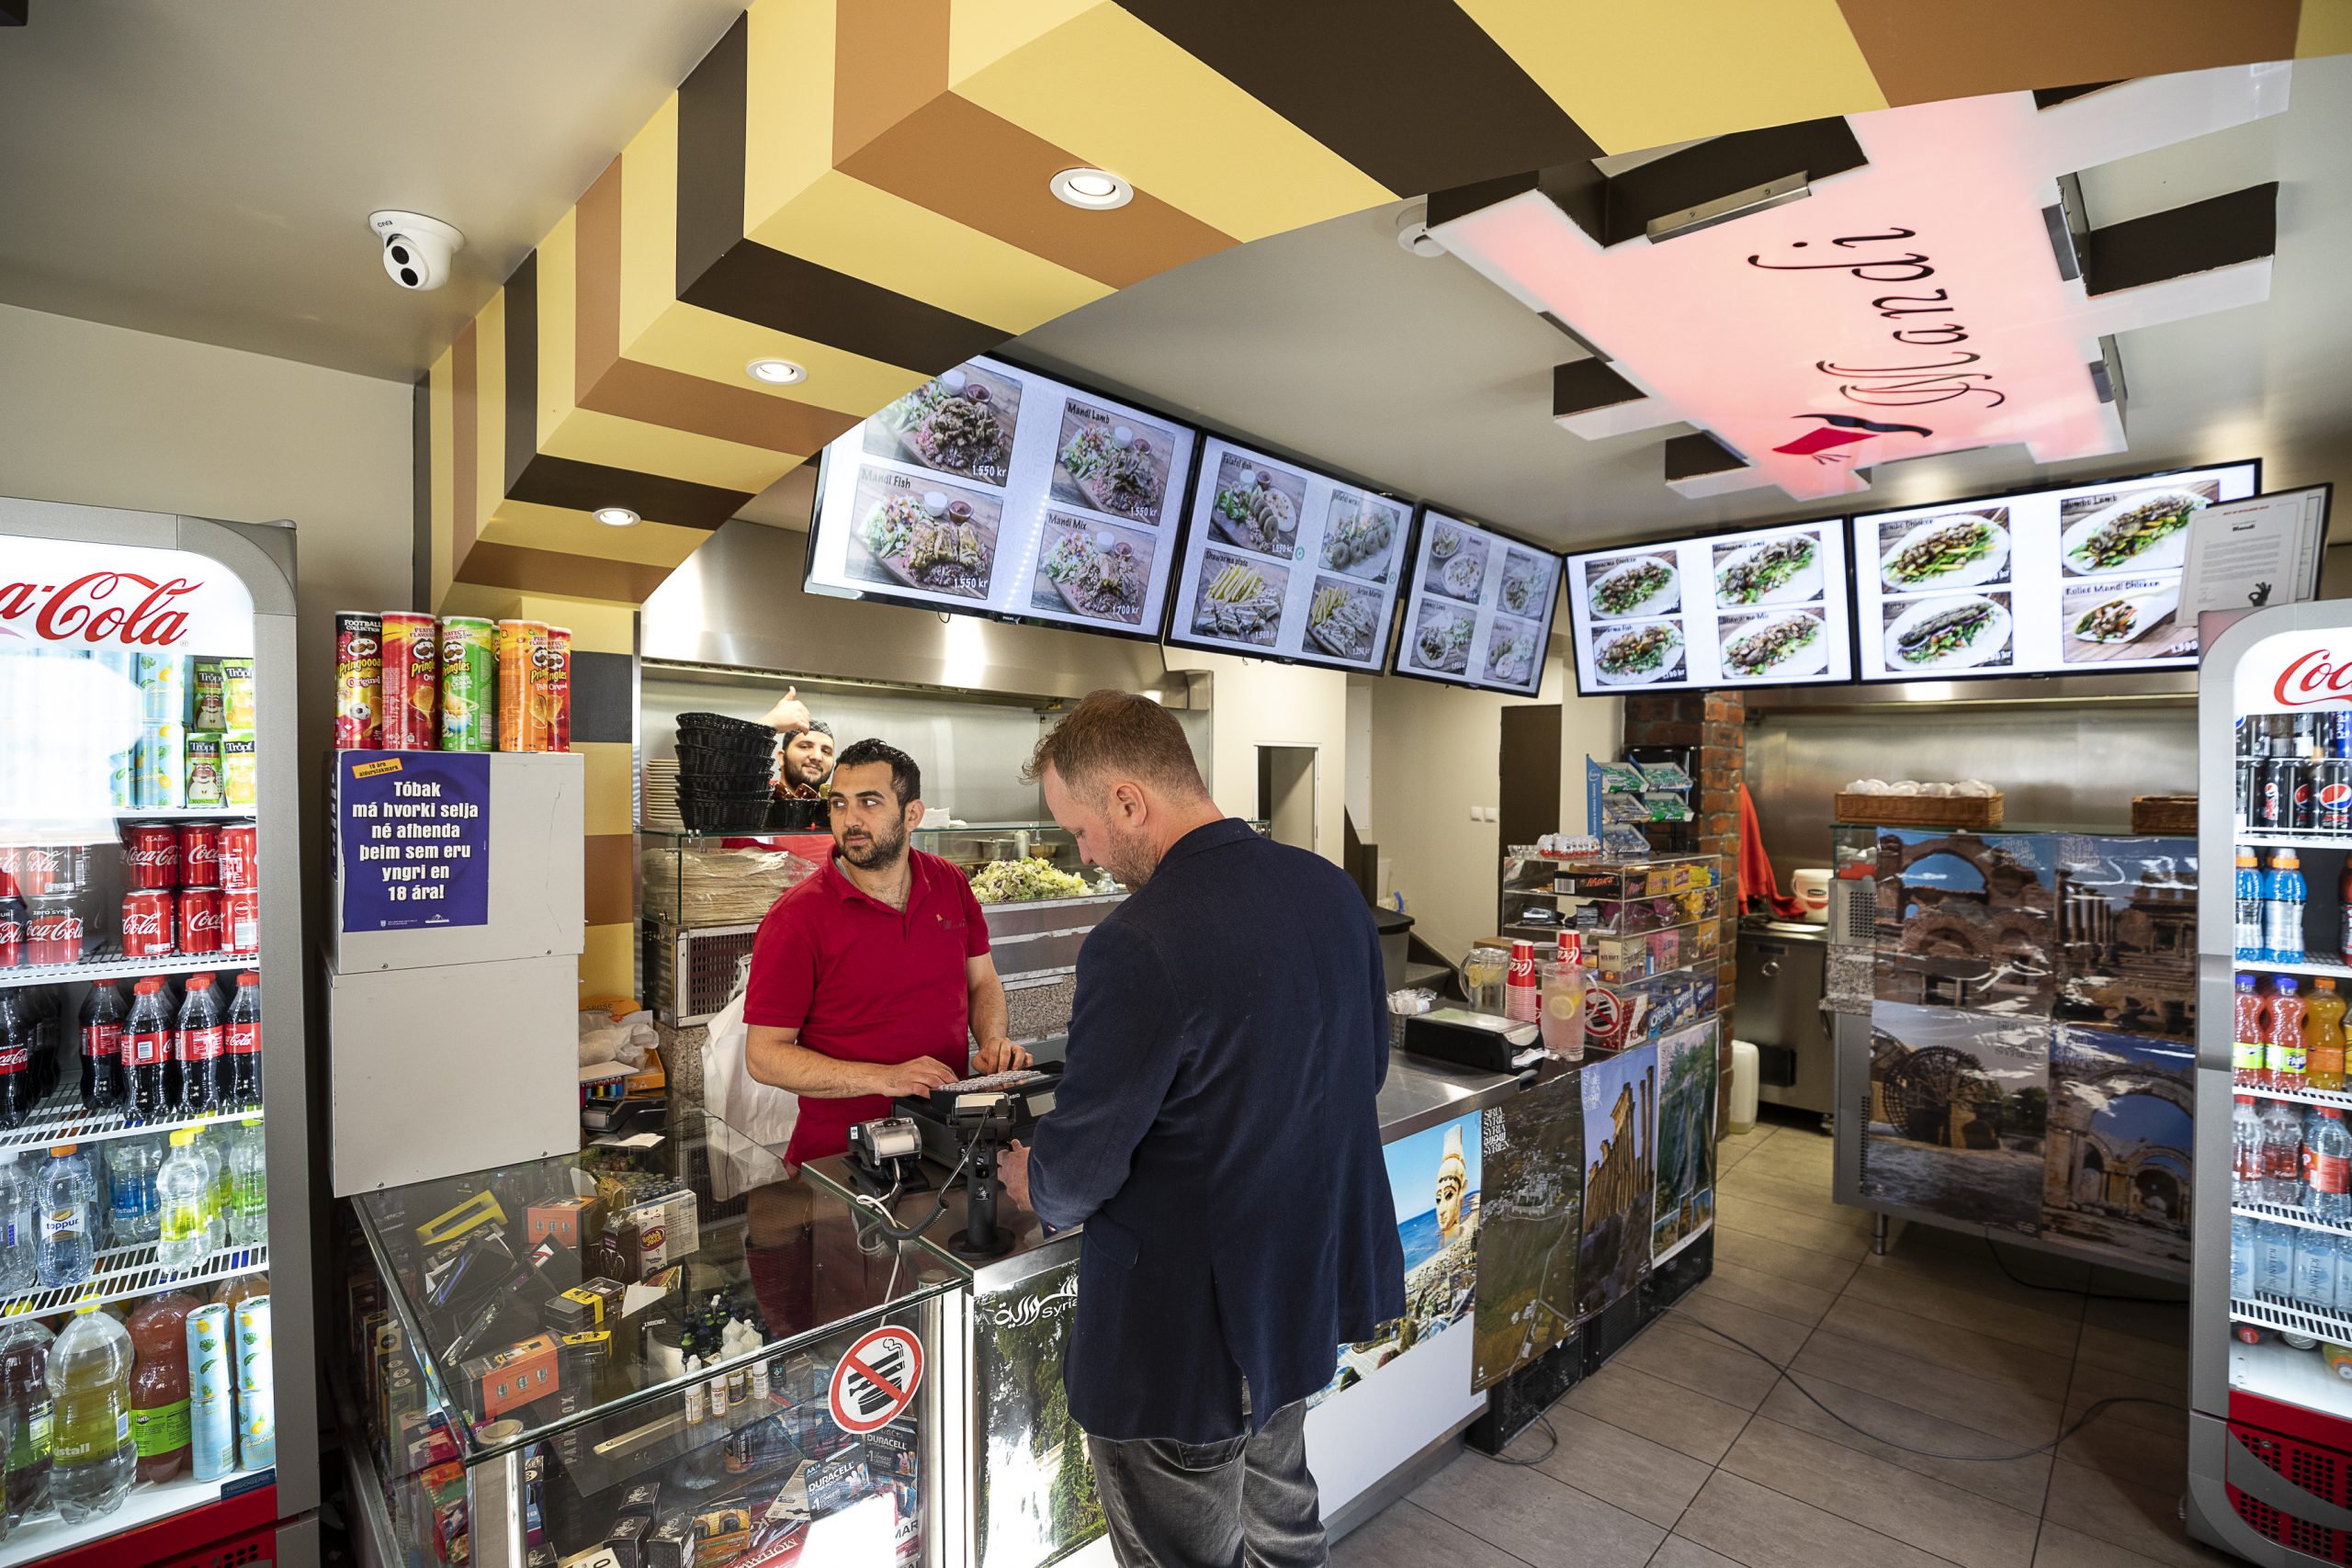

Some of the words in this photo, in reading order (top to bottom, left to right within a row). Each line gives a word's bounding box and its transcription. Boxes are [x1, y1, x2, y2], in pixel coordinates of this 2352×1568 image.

[1747, 227, 2006, 409] Mandi
[1067, 402, 1091, 419] Mandi
[1091, 409, 1111, 424] Lamb
[861, 470, 892, 485] Mandi
[893, 474, 911, 490] Fish
[972, 465, 995, 477] 1.550
[997, 467, 1007, 478] kr
[1130, 506, 1148, 517] 1.550
[1149, 508, 1158, 517] kr
[1047, 513, 1072, 527] Mandi
[1073, 519, 1087, 531] Mix
[954, 578, 977, 590] 1.550
[978, 579, 988, 589] kr
[1131, 605, 1139, 615] kr
[394, 781, 441, 797] Tóbak
[352, 801, 378, 818] má
[383, 802, 435, 818] hvorki
[440, 803, 479, 819] selja
[371, 823, 392, 839] né
[396, 823, 460, 839] afhenda
[359, 844, 401, 862] þeim
[405, 845, 439, 859] sem
[443, 845, 471, 858] eru
[381, 864, 426, 882] yngri
[430, 865, 449, 879] en
[388, 886, 406, 901] 18
[412, 885, 445, 900] ára!
[1676, 990, 1694, 1009] OREO
[1650, 1001, 1674, 1027] OREO
[1484, 1106, 1503, 1120] SIRIA
[1483, 1123, 1506, 1137] SYRIA
[1483, 1139, 1510, 1157] SYRIEN
[46, 1218, 80, 1232] toppur
[561, 1395, 578, 1465] PARAOX
[866, 1435, 907, 1450] DURACELL
[808, 1461, 854, 1493] DURACELL
